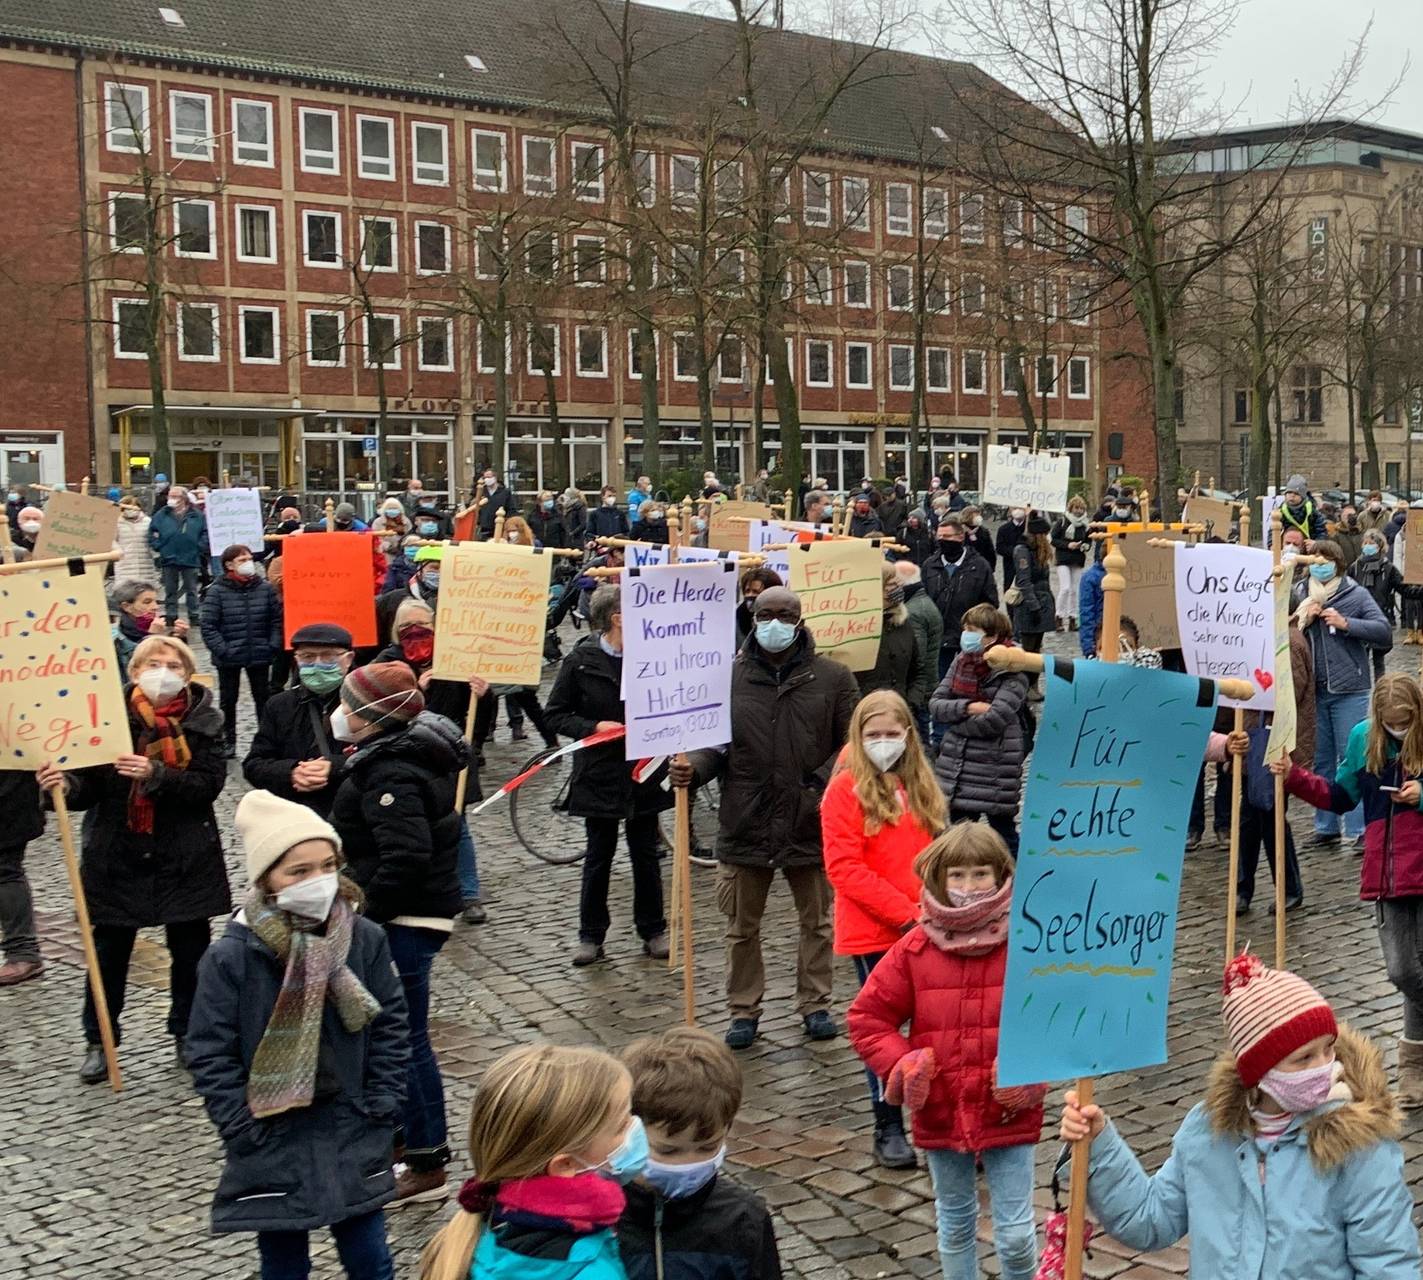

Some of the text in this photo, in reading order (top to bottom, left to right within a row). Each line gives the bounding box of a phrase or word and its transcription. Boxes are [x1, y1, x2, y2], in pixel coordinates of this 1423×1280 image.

[494, 565, 531, 579] eine
[804, 562, 848, 587] Für
[1187, 566, 1228, 594] Uns
[448, 582, 544, 606] vollständige
[631, 578, 726, 608] Die Herde
[33, 602, 91, 634] den
[1187, 601, 1265, 627] die Kirche
[1193, 628, 1244, 648] sehr am
[674, 644, 721, 672] ihrem
[647, 681, 709, 713] Hirten
[1069, 705, 1141, 769] Für
[1047, 786, 1136, 842] echte
[1021, 870, 1170, 967] Seelsorger
